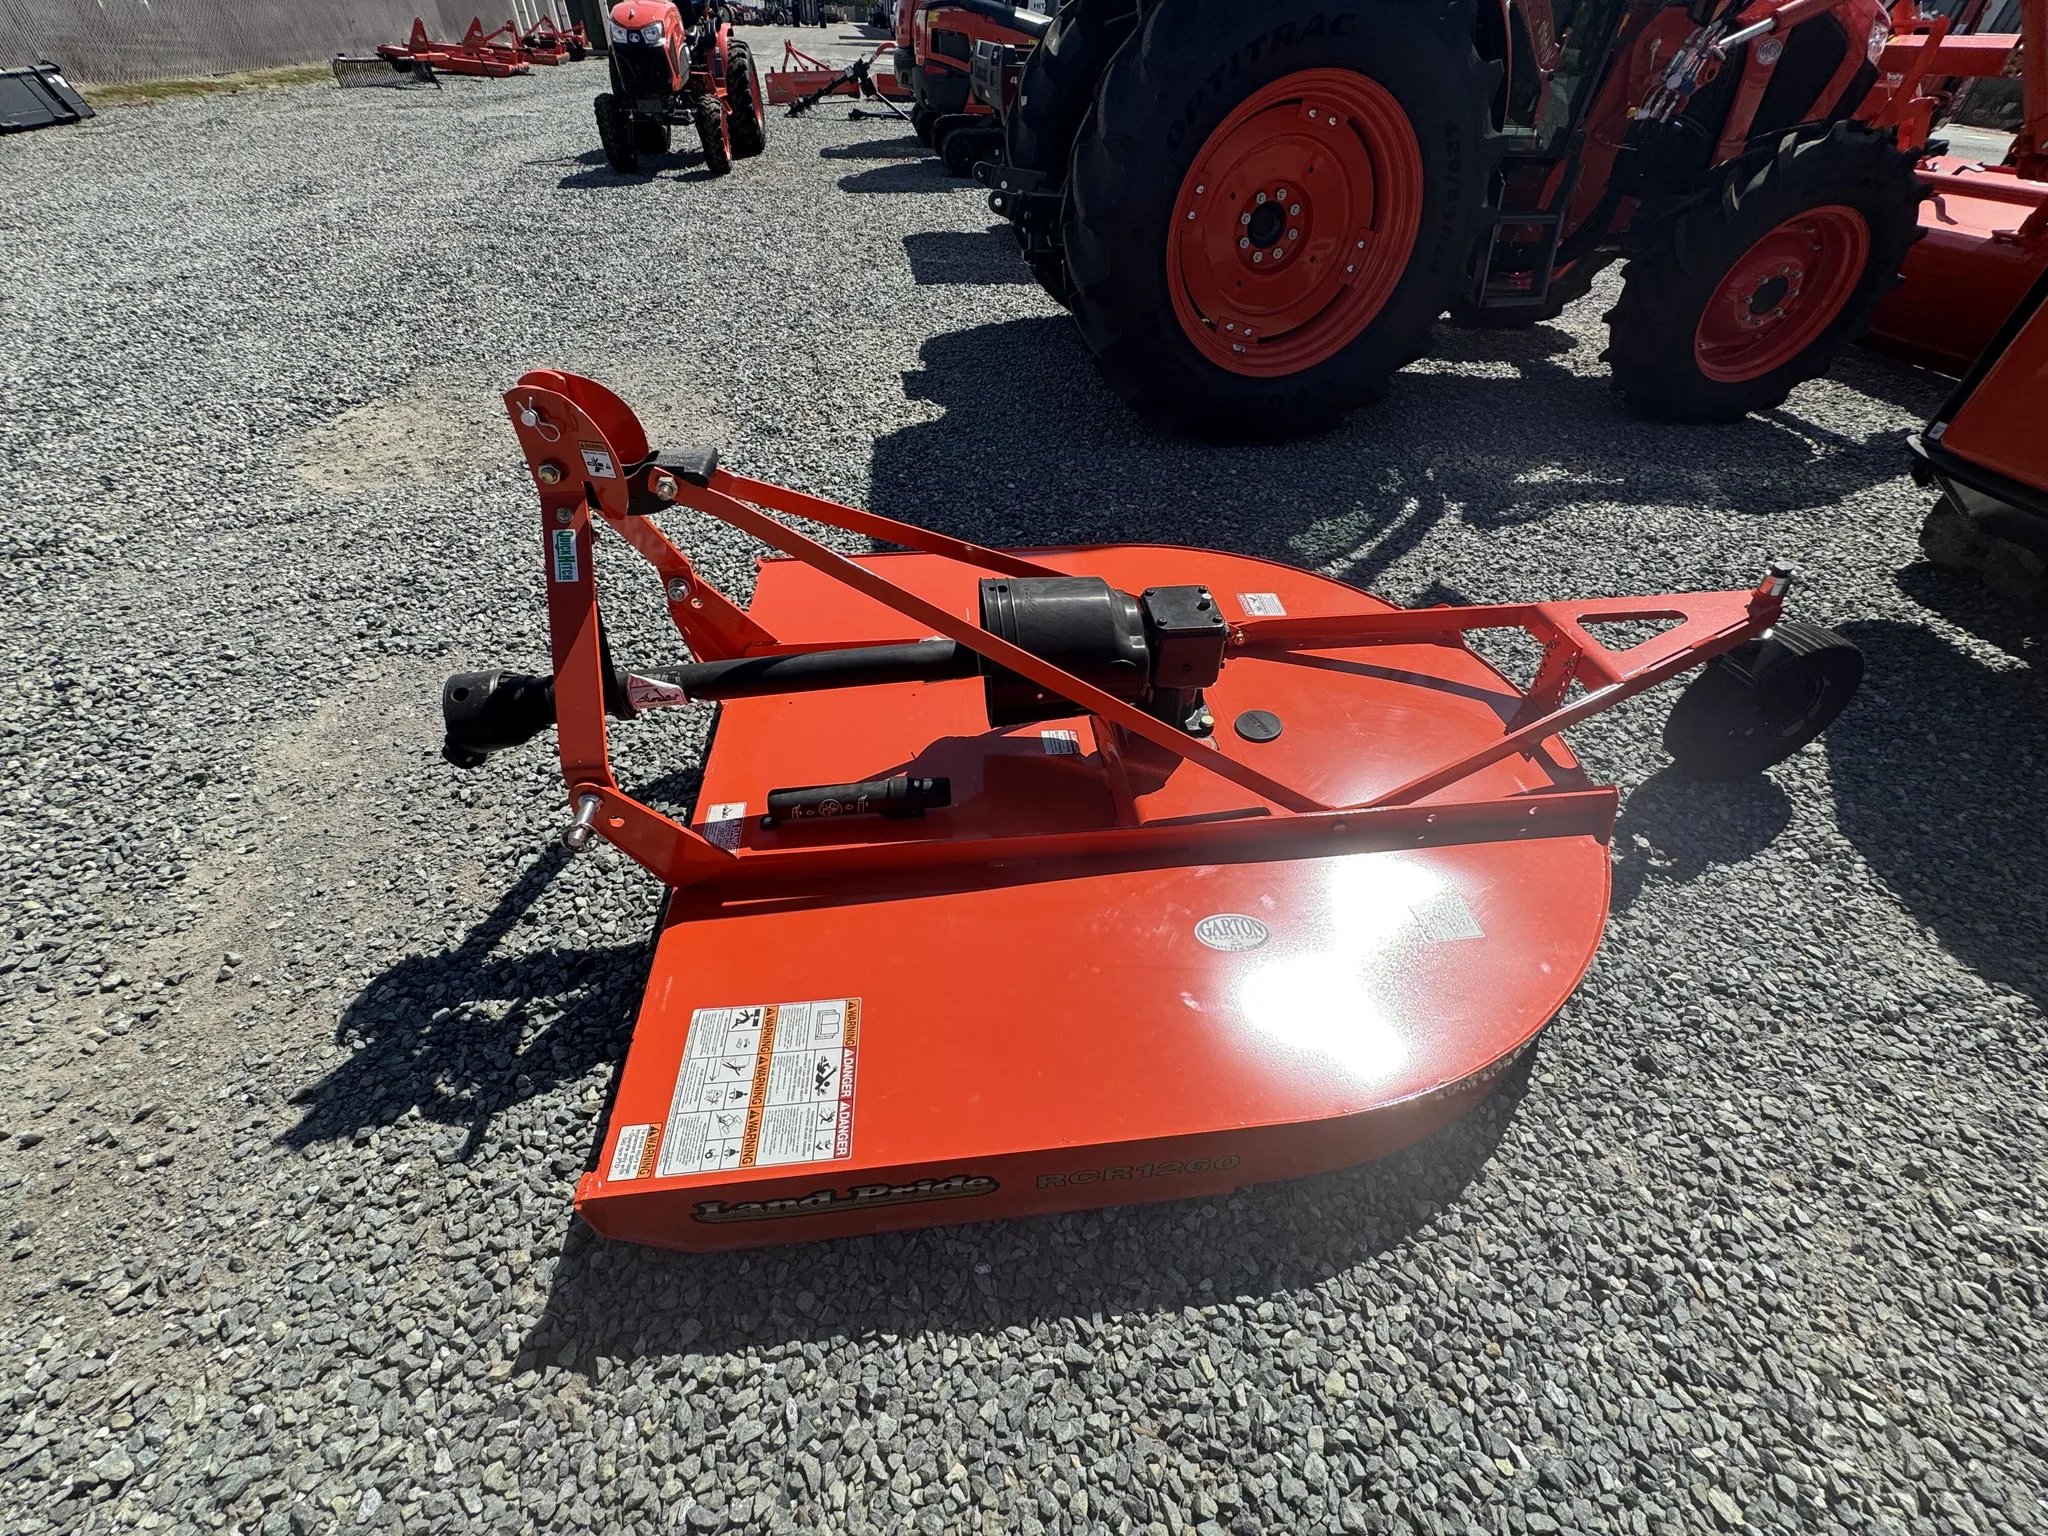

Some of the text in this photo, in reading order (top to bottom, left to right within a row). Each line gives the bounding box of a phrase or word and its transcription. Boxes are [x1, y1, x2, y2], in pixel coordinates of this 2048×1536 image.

[1167, 13, 1355, 150] OPTITRAC
[1200, 918, 1264, 937] GARTON
[760, 1016, 774, 1053] WARNING
[845, 1009, 857, 1046] WARNING
[752, 1065, 768, 1105] WARNING
[841, 1058, 854, 1097] DANGER
[742, 1119, 759, 1164] WARNING
[837, 1112, 850, 1156] DANGER
[640, 1136, 657, 1175] WARNING
[1037, 1155, 1241, 1189] RCR1260
[697, 1175, 994, 1220] Land Pride
